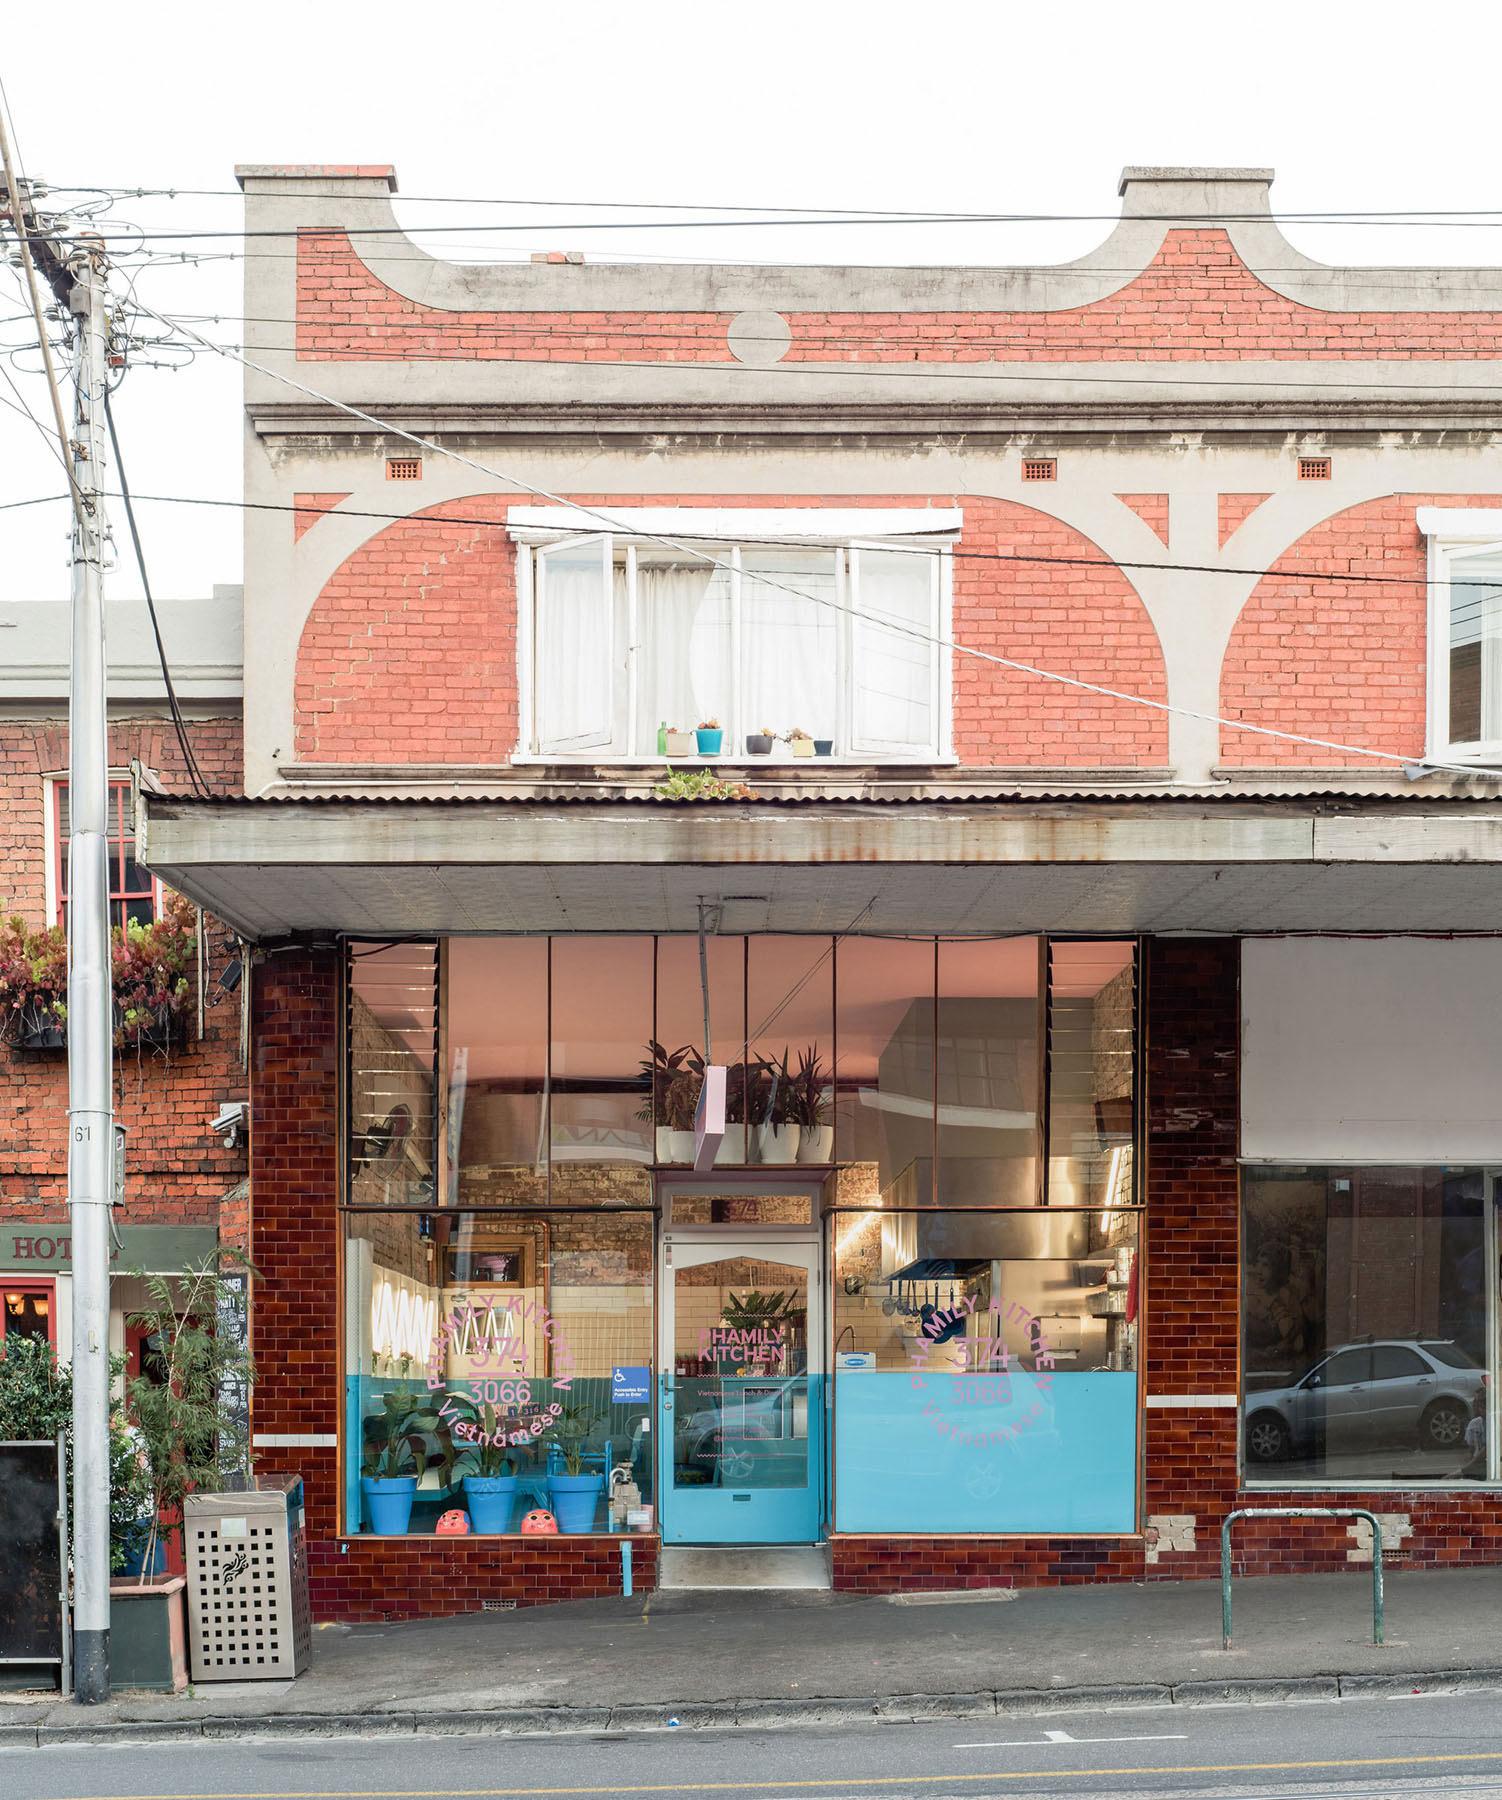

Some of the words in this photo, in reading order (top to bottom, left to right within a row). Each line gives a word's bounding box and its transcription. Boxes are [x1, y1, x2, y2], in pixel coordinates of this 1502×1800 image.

[75, 1126, 91, 1142] 61
[723, 1198, 759, 1216] 374
[12, 1237, 119, 1261] HOT
[426, 1294, 495, 1390] PHAMILY
[508, 1295, 574, 1390] KITCHEN
[698, 1328, 784, 1344] PHAMILY
[910, 1294, 978, 1390] PHAMILY
[989, 1295, 1055, 1390] KITCHEN
[470, 1337, 530, 1367] 374
[698, 1346, 785, 1361] KITCHEN
[952, 1337, 1011, 1368] 374
[468, 1381, 531, 1403] 3066
[951, 1381, 1012, 1404] 3066
[438, 1398, 563, 1447] Vietnamese
[922, 1399, 1043, 1447] Vietnamese
